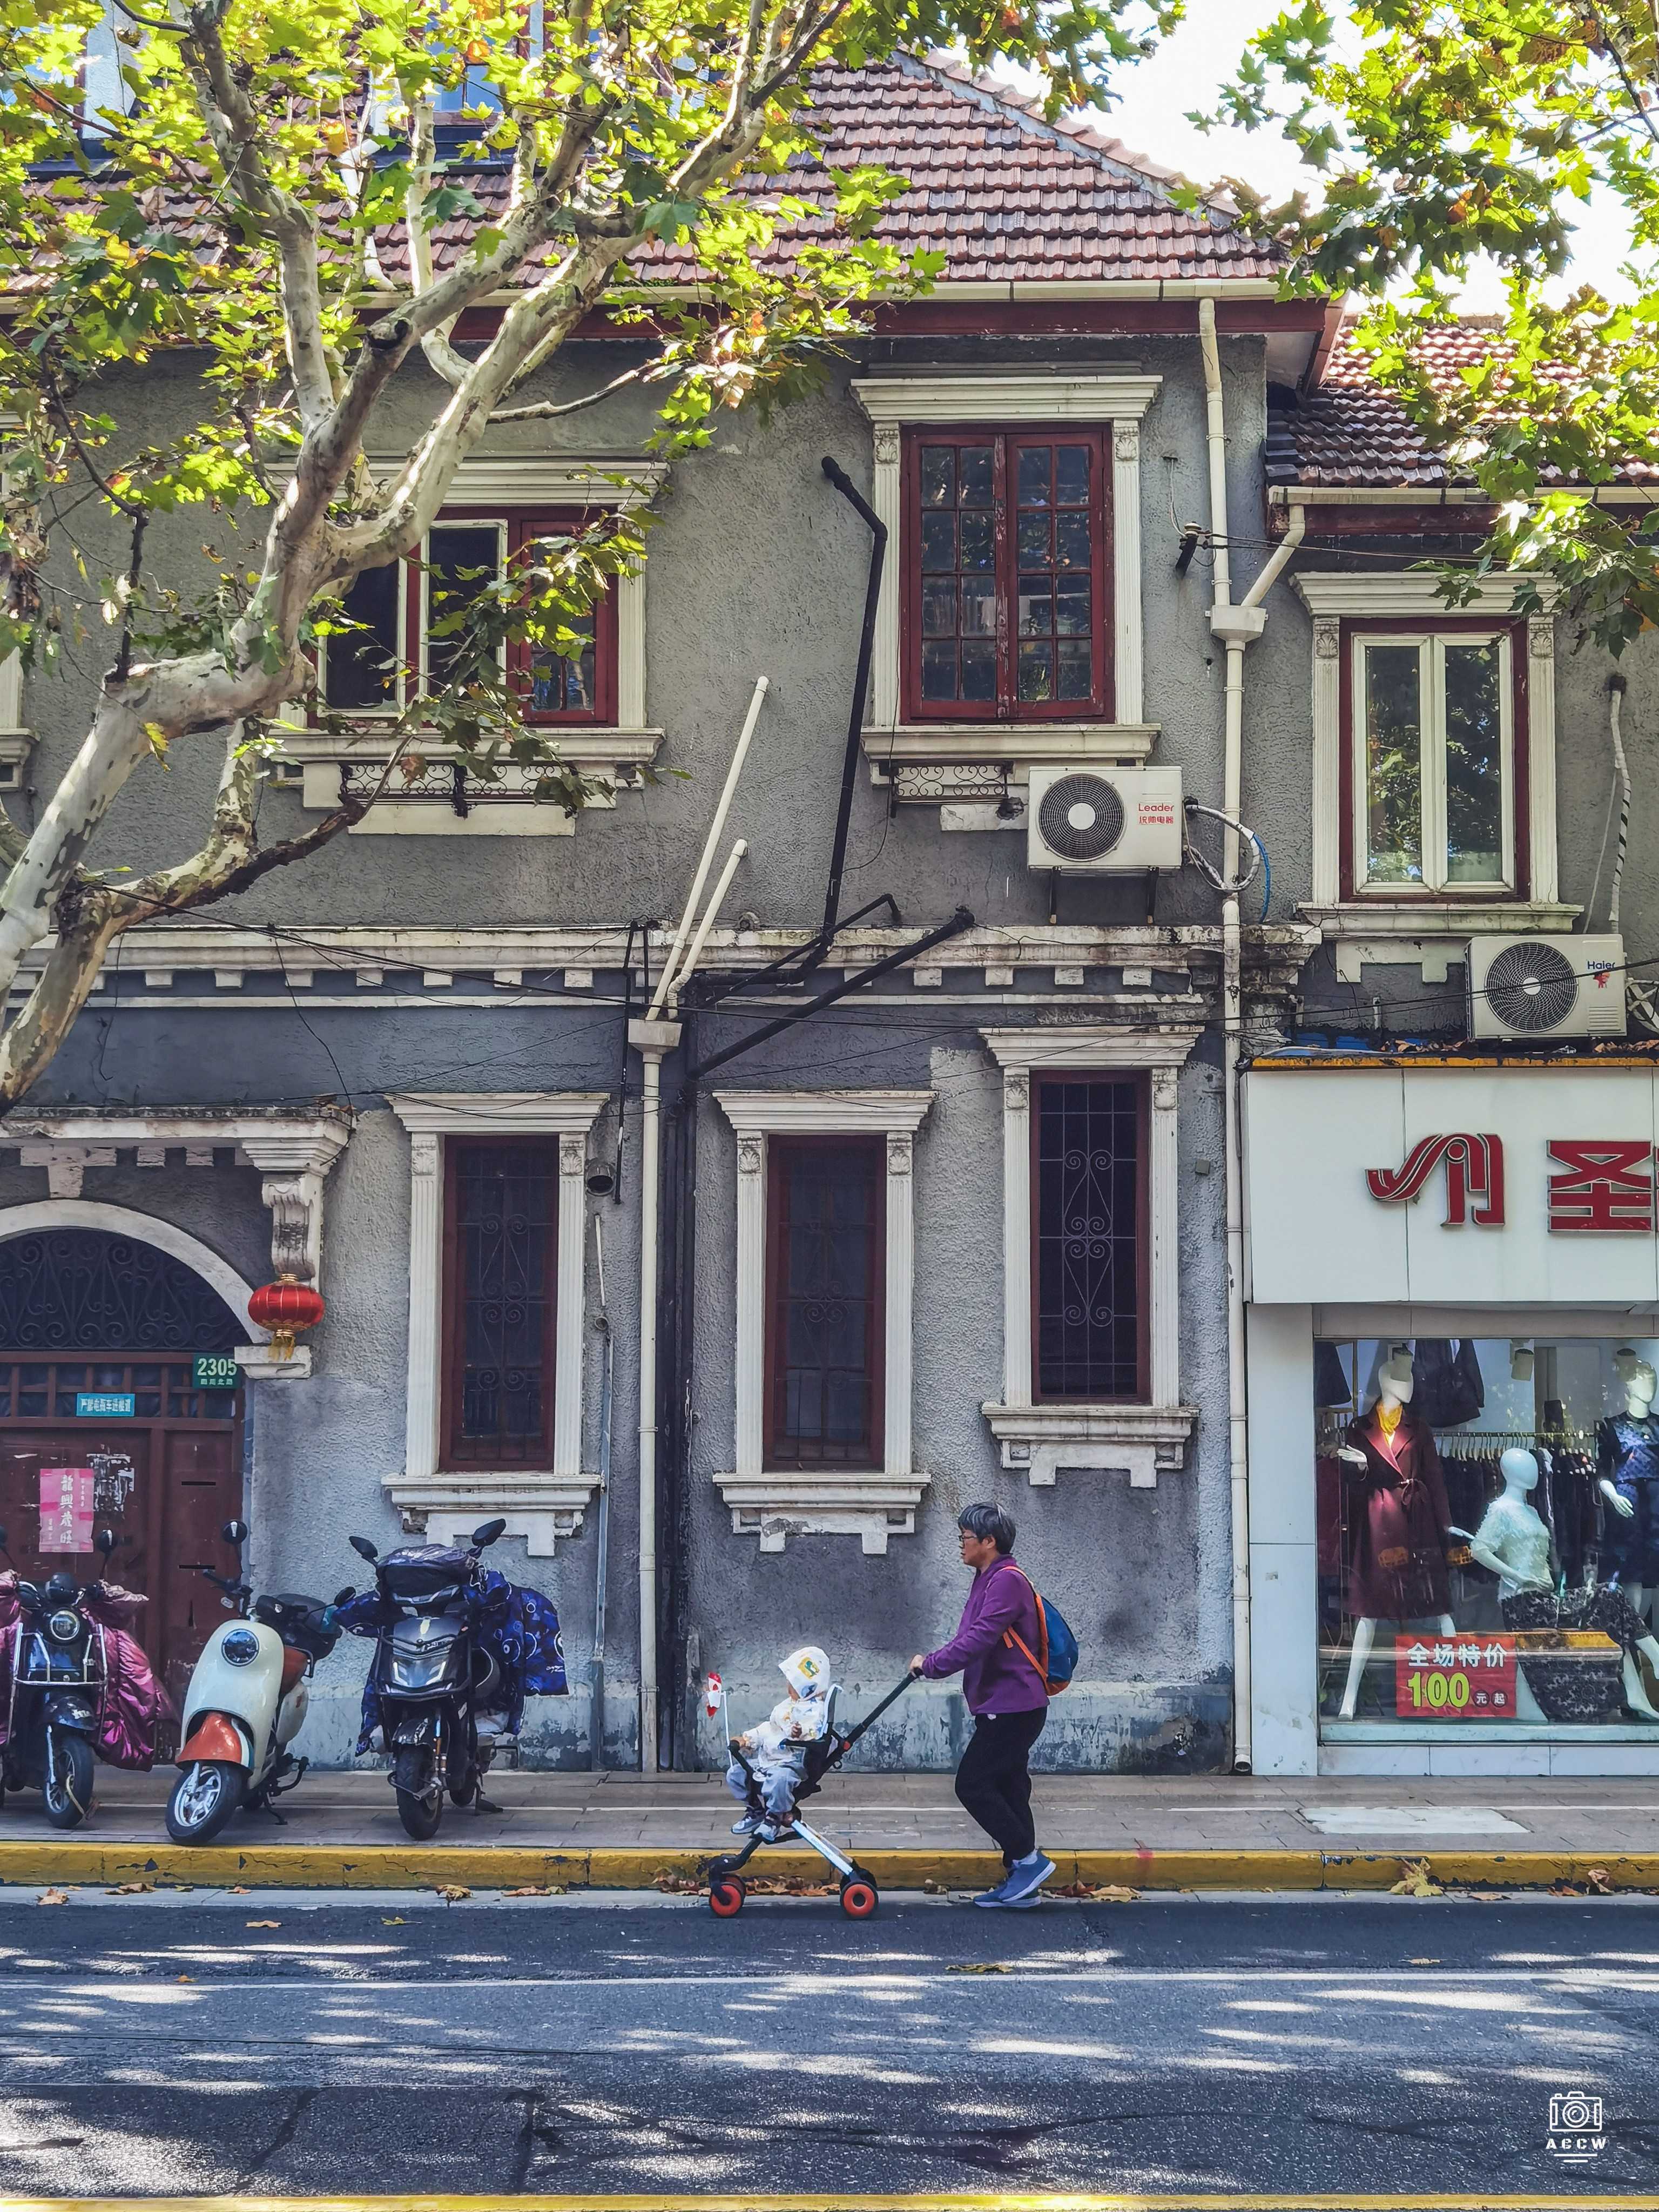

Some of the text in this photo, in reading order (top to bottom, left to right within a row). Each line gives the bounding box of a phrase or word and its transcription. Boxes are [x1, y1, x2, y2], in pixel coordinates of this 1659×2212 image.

[1138, 802, 1175, 811] Leader
[1587, 960, 1615, 970] Haier
[1546, 1140, 1659, 1233] 圣
[197, 1358, 237, 1376] 2305
[1407, 1642, 1507, 1668] 全场特价
[1407, 1671, 1505, 1708] 100 元起
